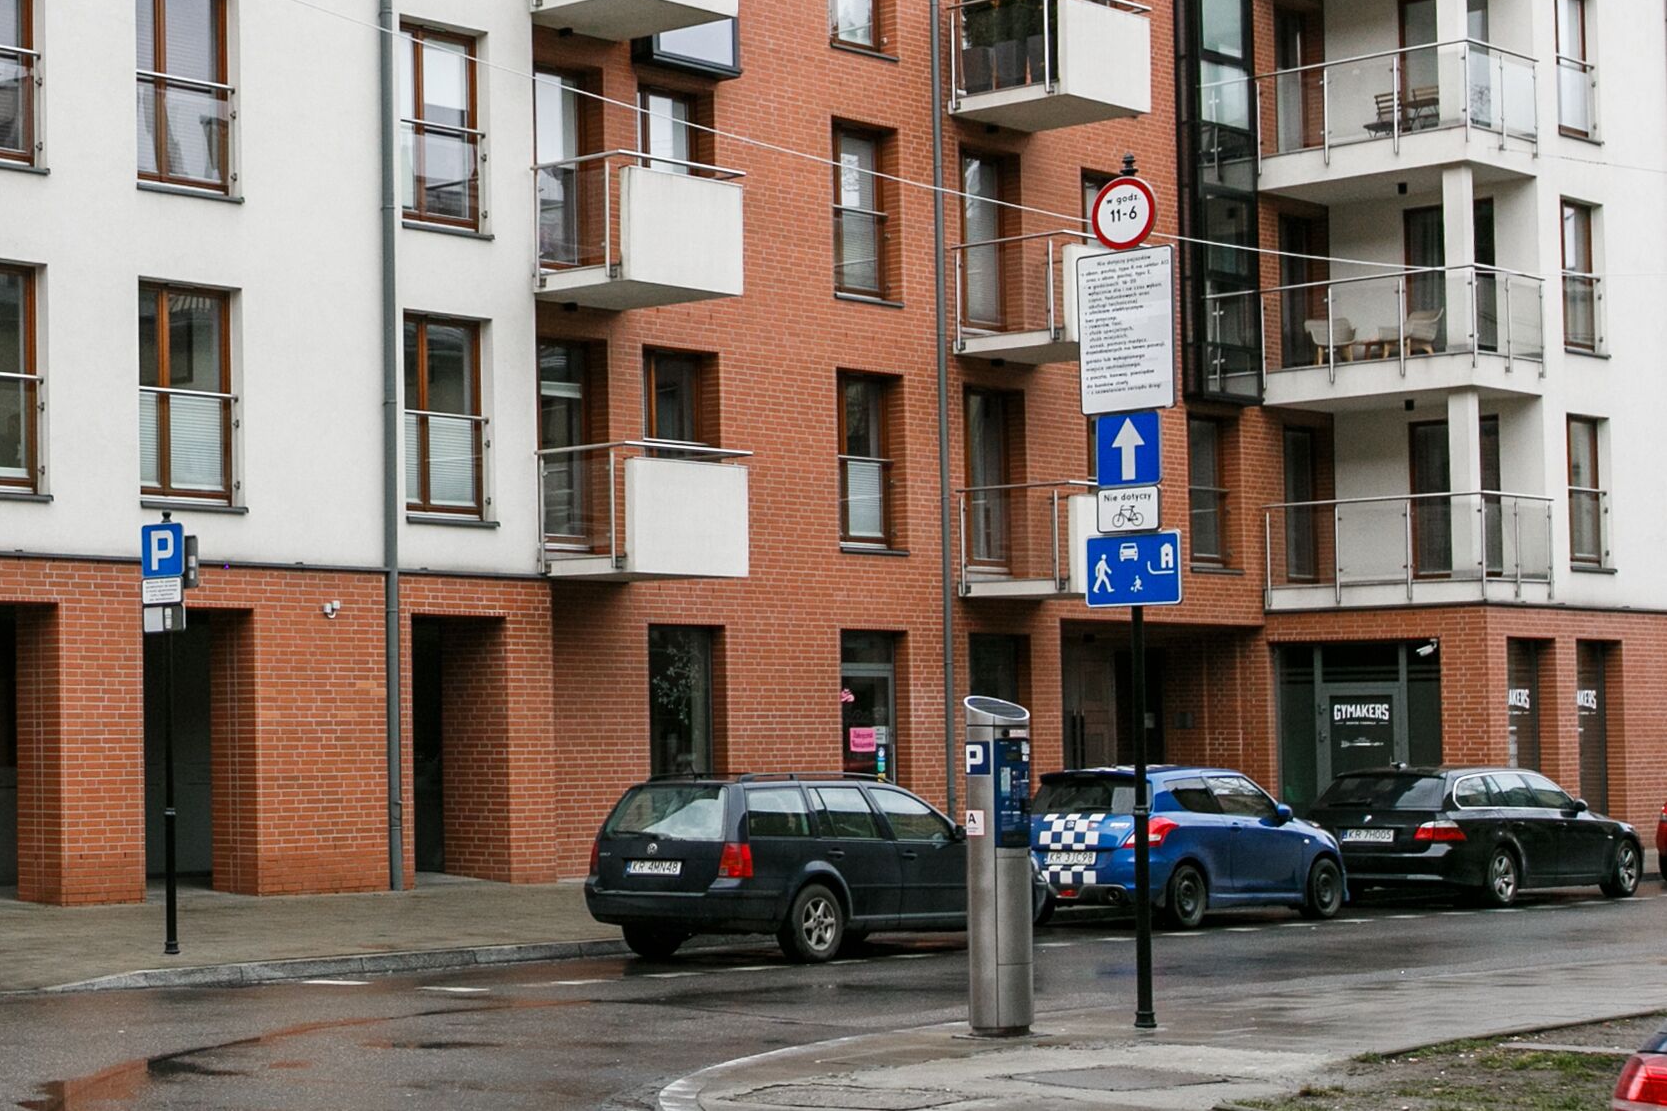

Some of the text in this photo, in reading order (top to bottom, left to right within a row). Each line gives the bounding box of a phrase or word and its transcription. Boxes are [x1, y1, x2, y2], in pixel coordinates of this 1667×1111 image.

[1110, 205, 1137, 223] 11-6
[1104, 493, 1152, 502] Nie dotyczy
[150, 530, 174, 571] P
[1334, 704, 1390, 721] GYMAKERS
[966, 744, 984, 774] P
[968, 813, 976, 825] A
[1348, 829, 1362, 839] KR
[1049, 852, 1062, 862] KR
[633, 860, 645, 873] KR
